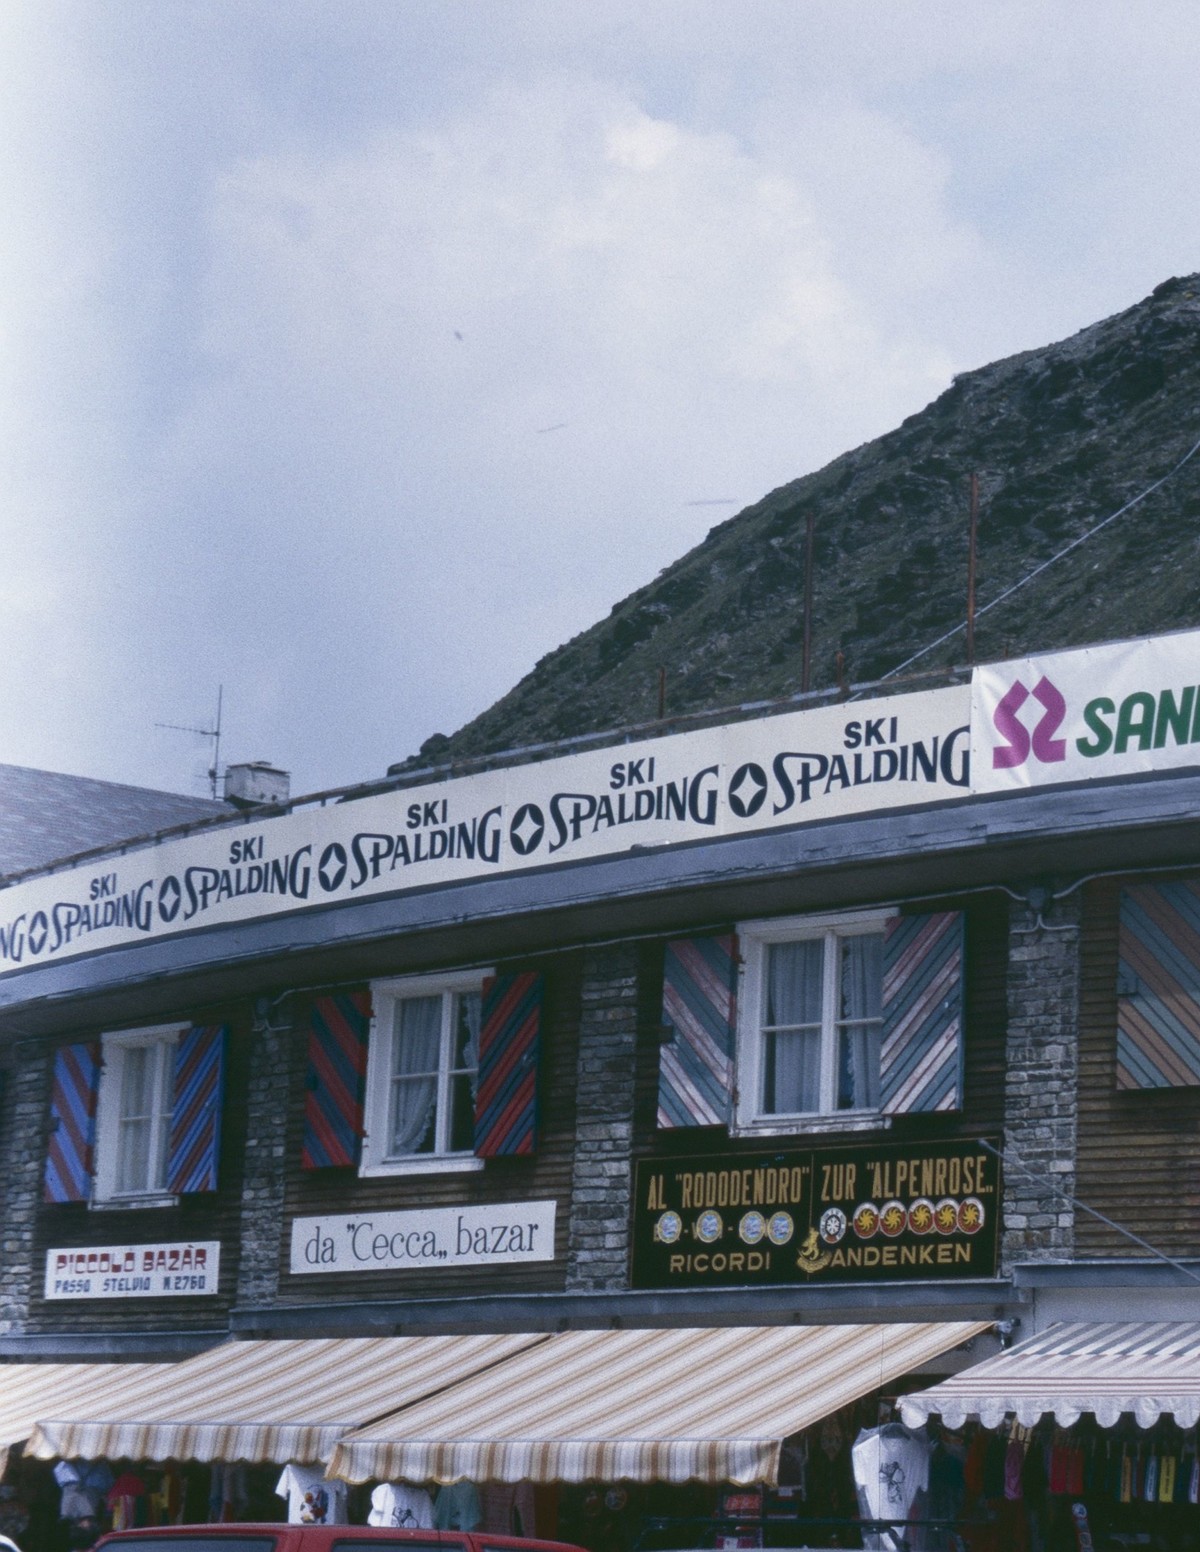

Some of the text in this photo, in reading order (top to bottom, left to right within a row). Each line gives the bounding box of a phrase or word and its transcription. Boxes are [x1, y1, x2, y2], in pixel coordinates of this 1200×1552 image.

[843, 716, 898, 750] SKI
[610, 757, 655, 790] SKI
[773, 725, 970, 817] SPALDING
[405, 800, 448, 830] SKI
[549, 764, 720, 853] SPALDING
[229, 836, 265, 865] SKI
[350, 804, 502, 889] SPALDING
[90, 872, 117, 901] SKI
[184, 842, 313, 920] SPALDING
[50, 879, 153, 953] SPALDING
[647, 1174, 667, 1210] AL
[821, 1163, 857, 1201] ZUR
[305, 1226, 337, 1264] da
[455, 1216, 539, 1256] bazar
[829, 1243, 972, 1268] ANDENKEN
[56, 1252, 135, 1275] PICCOLO
[670, 1252, 771, 1273] RICORDI
[54, 1279, 91, 1293] PASSO
[103, 1278, 150, 1293] STELVIO
